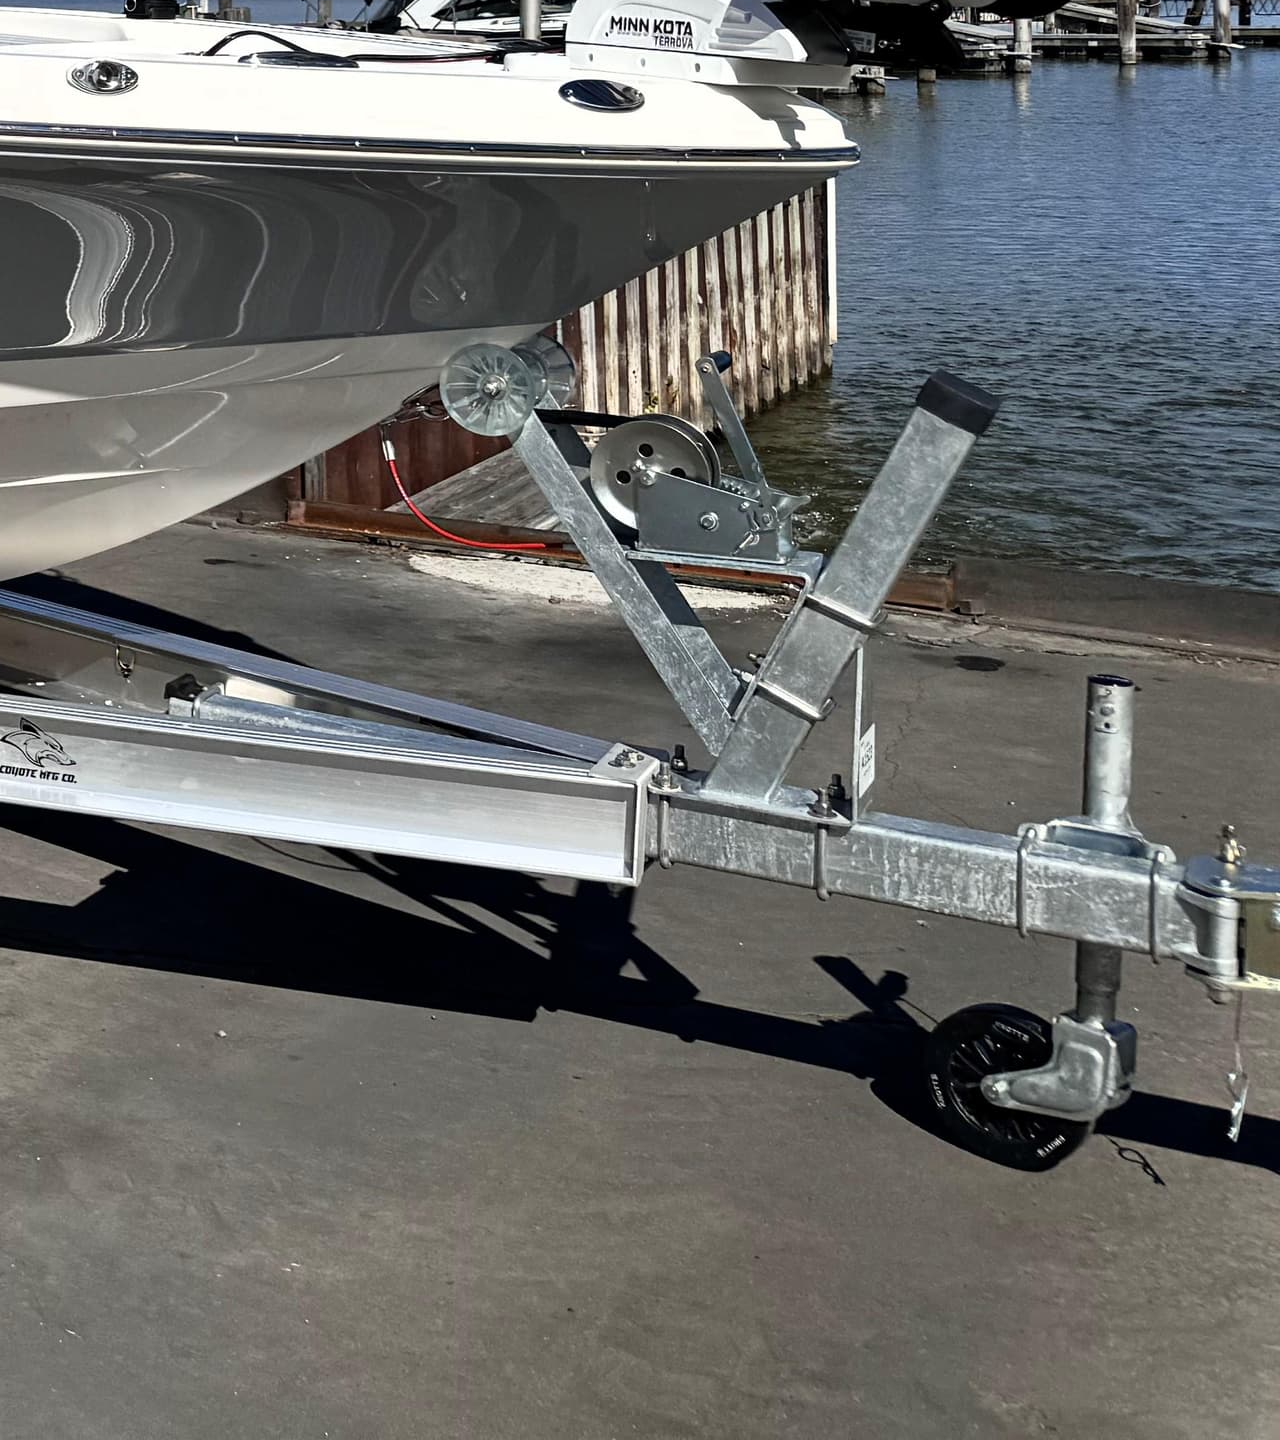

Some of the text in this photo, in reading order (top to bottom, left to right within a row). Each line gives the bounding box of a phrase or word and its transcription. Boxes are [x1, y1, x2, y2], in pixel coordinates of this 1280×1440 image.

[610, 15, 693, 37] MINN KOTA
[654, 35, 694, 50] TERROVA
[0, 765, 77, 784] COYOTE MFG CO.
